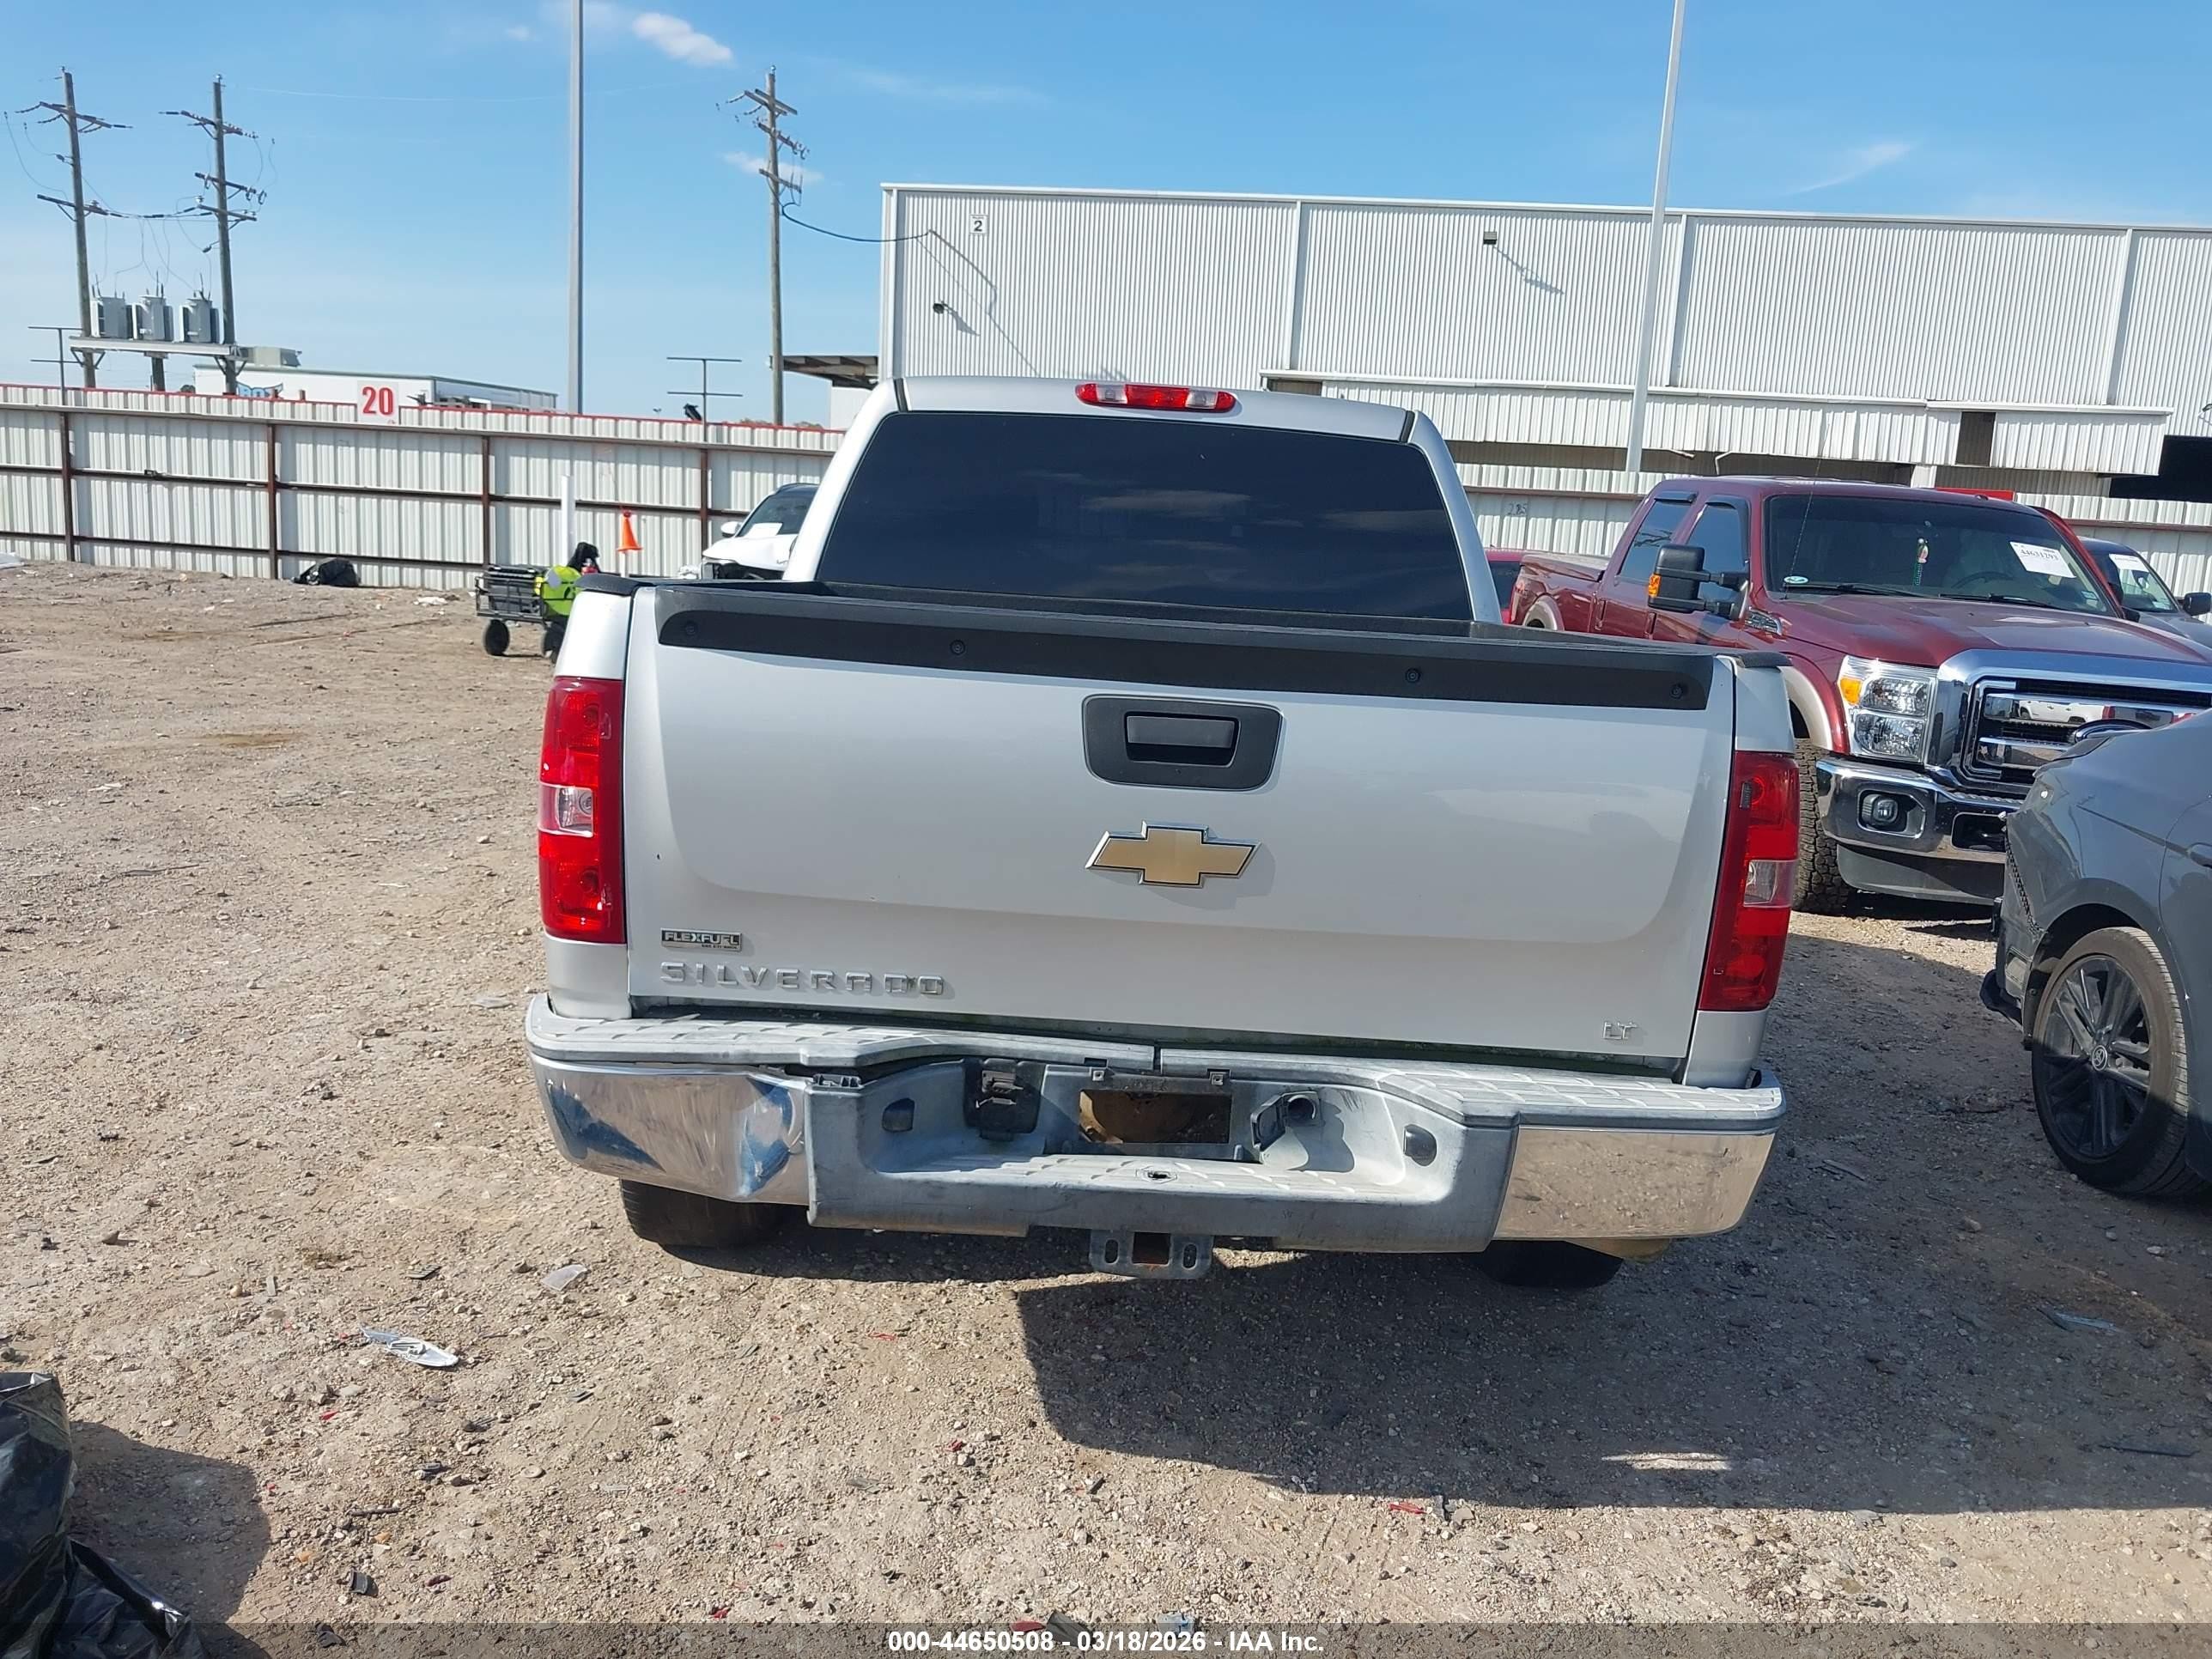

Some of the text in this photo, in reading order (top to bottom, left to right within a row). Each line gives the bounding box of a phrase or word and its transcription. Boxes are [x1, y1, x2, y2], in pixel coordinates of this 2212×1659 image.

[974, 220, 983, 232] 2
[362, 386, 394, 416] 20
[665, 932, 739, 945] FLEXFUEL
[659, 961, 944, 995] SILVERADO
[1602, 1022, 1638, 1040] LT
